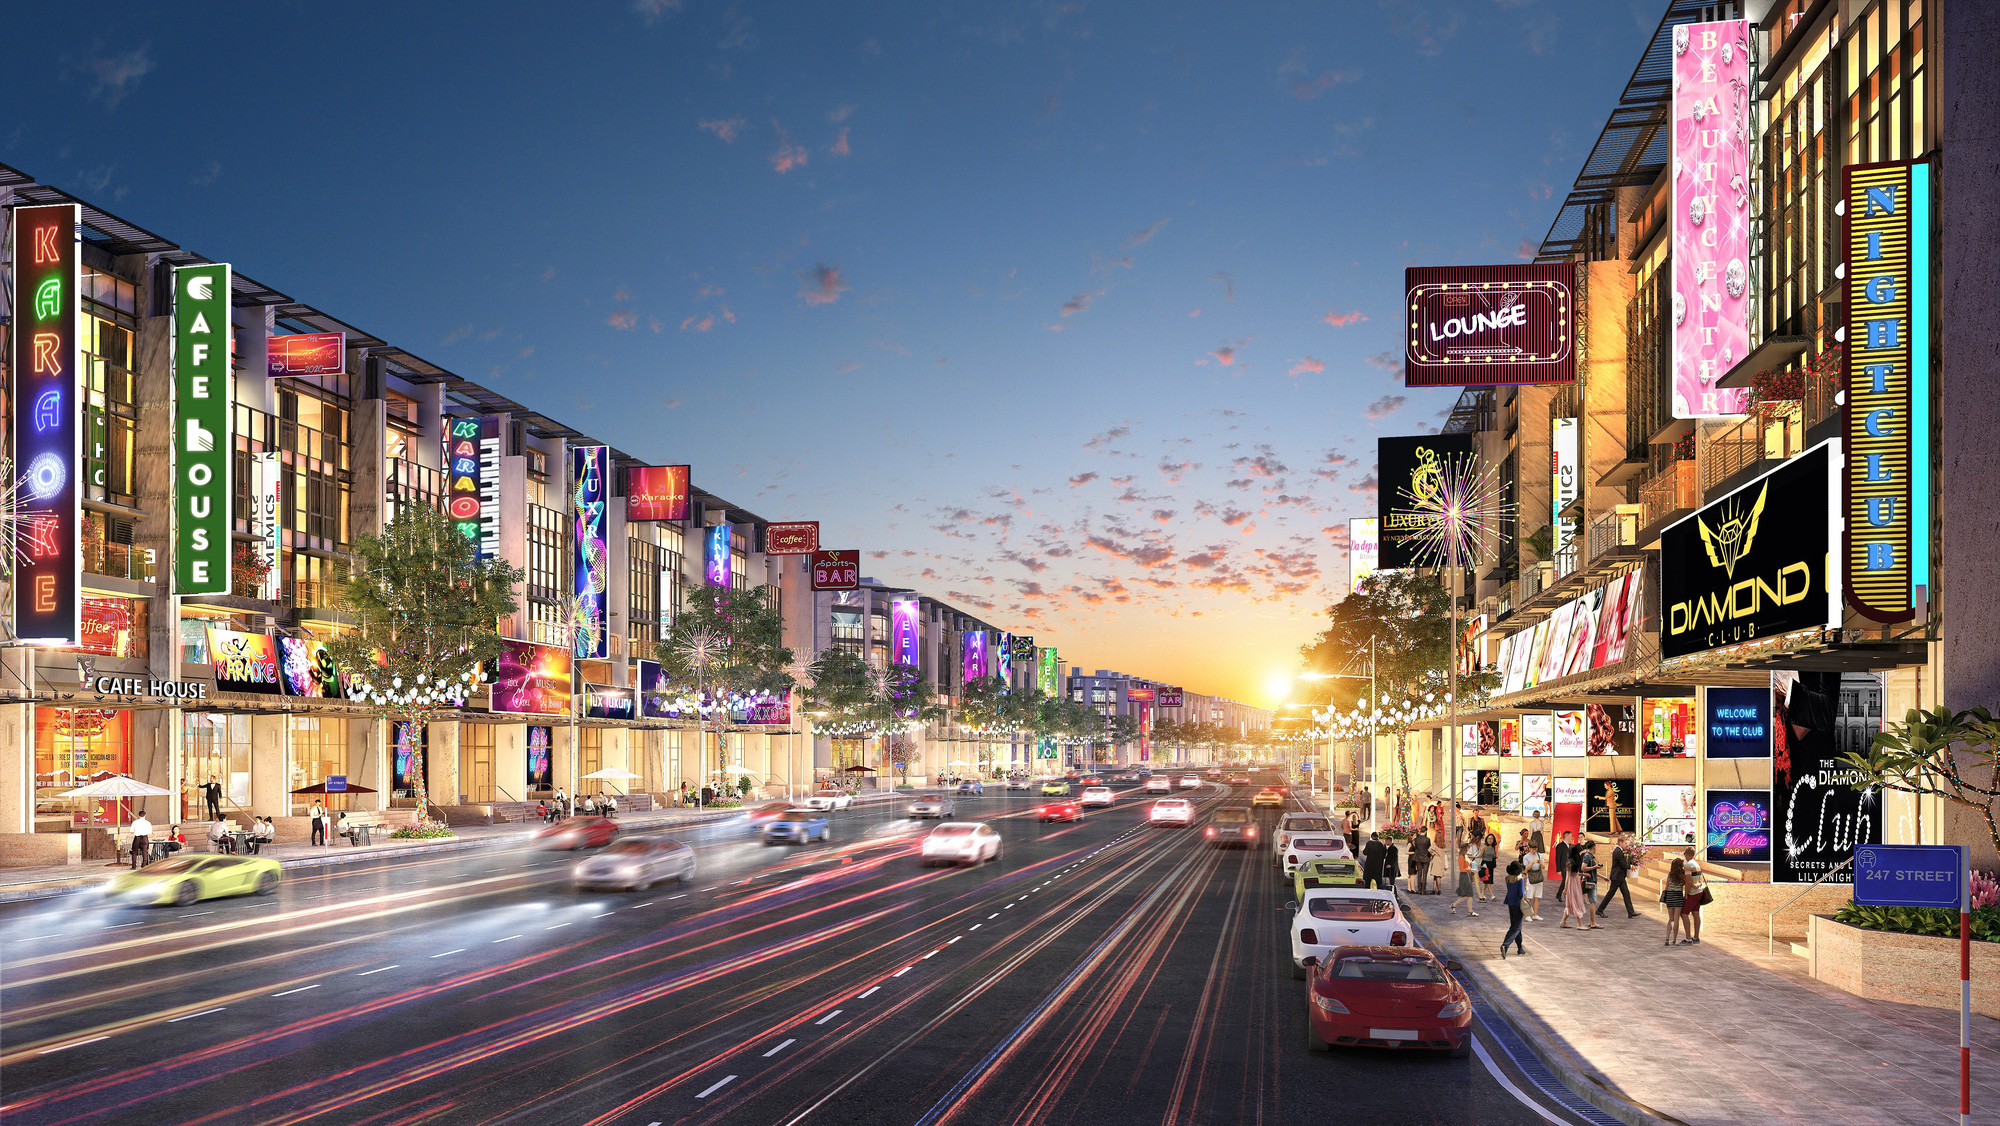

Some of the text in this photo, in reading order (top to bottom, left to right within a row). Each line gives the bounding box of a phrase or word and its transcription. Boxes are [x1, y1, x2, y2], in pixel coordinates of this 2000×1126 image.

[1446, 296, 1466, 304] OPEN
[1430, 304, 1527, 342] LOUNGE
[187, 276, 215, 398] CAFE
[304, 364, 324, 373] 2020
[28, 226, 66, 612] KARAOKE
[451, 421, 480, 541] KARAOK
[641, 493, 684, 501] Karaoke
[780, 535, 803, 545] coffee
[820, 560, 849, 568] Sports
[816, 569, 856, 583] BAR
[1670, 562, 1810, 636] DIAMOND
[81, 619, 109, 634] offee
[216, 661, 276, 684] KARAOKE
[96, 676, 206, 699] CAFE HOUSE
[536, 679, 557, 690] MUSIC
[590, 693, 632, 713] lux luxury
[1161, 696, 1181, 704] BAR
[1717, 709, 1756, 718] WELCOME
[1712, 727, 1763, 736] TO THE CLUB
[1819, 759, 1834, 768] THE
[1818, 770, 1870, 785] DIAMON
[1785, 774, 1871, 856] Club
[1708, 832, 1767, 847] DJ Music
[1790, 861, 1825, 869] SECRETS
[1798, 872, 1818, 881] LILY
[1866, 870, 1954, 881] 247 STREET
